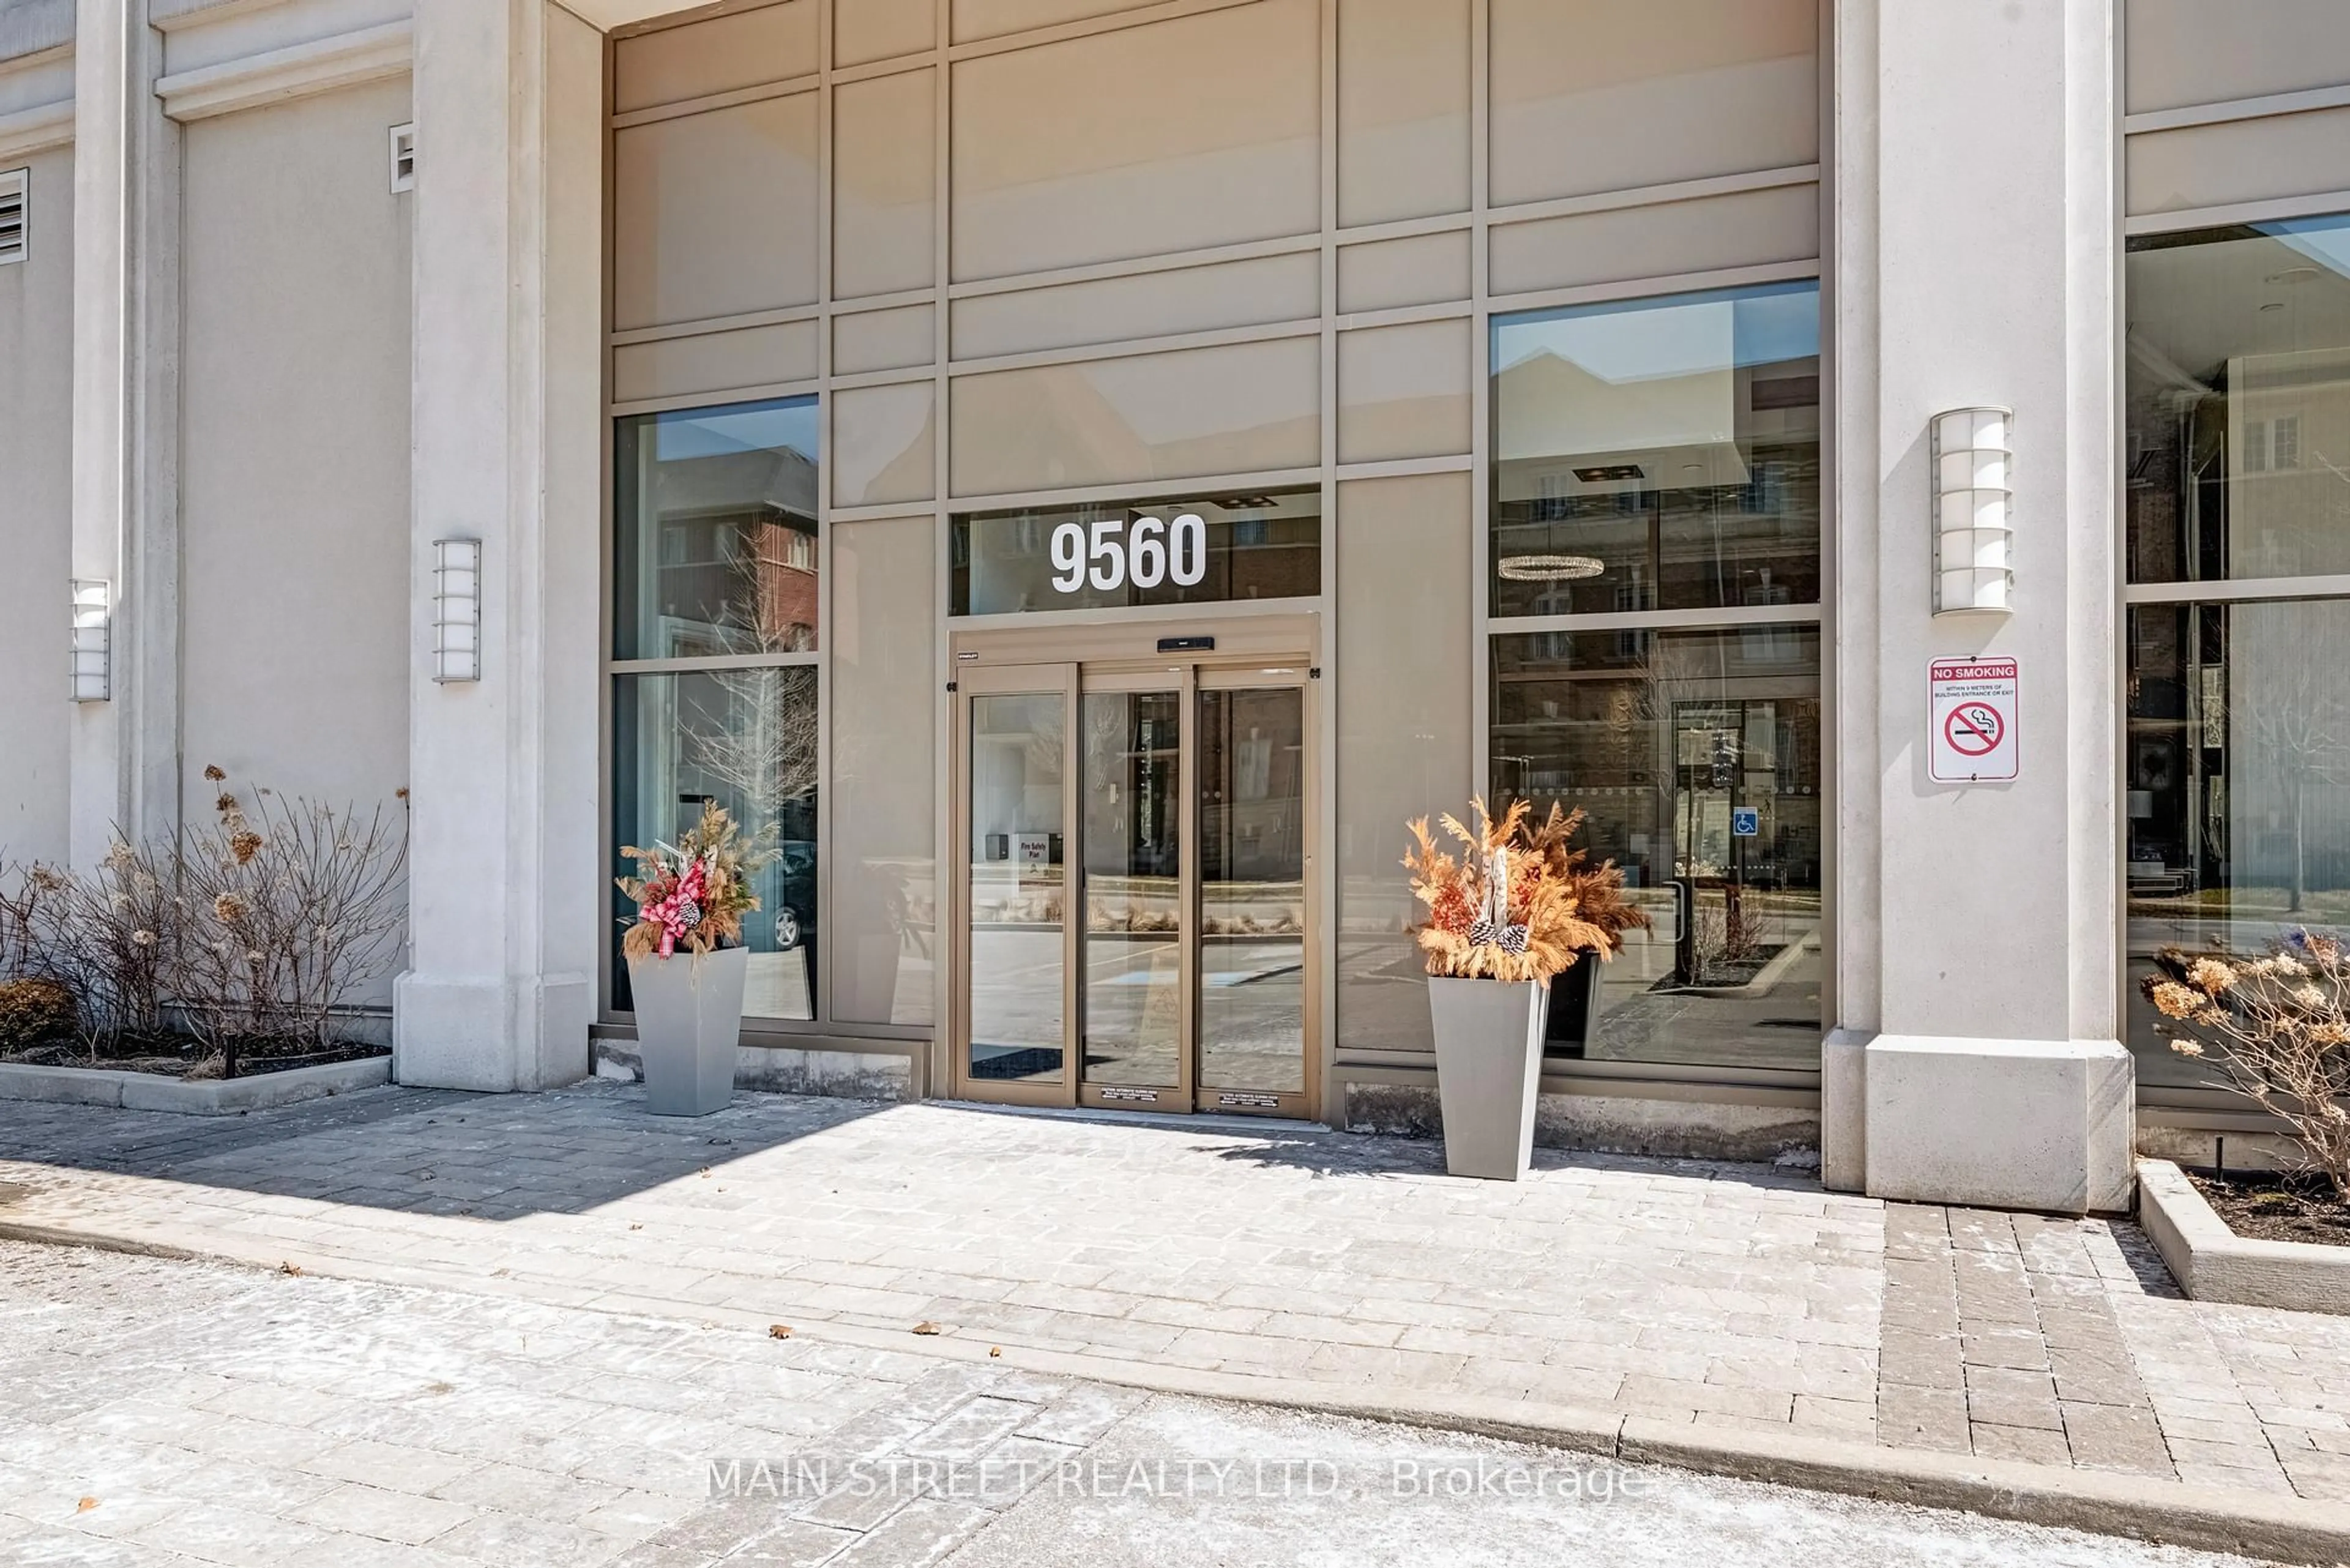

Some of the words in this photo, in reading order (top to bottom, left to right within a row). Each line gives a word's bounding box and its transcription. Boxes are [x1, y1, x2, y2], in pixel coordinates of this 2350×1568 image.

[1051, 514, 1206, 593] 9560
[1934, 669, 1952, 678] NO
[1955, 666, 2015, 678] SMOKING
